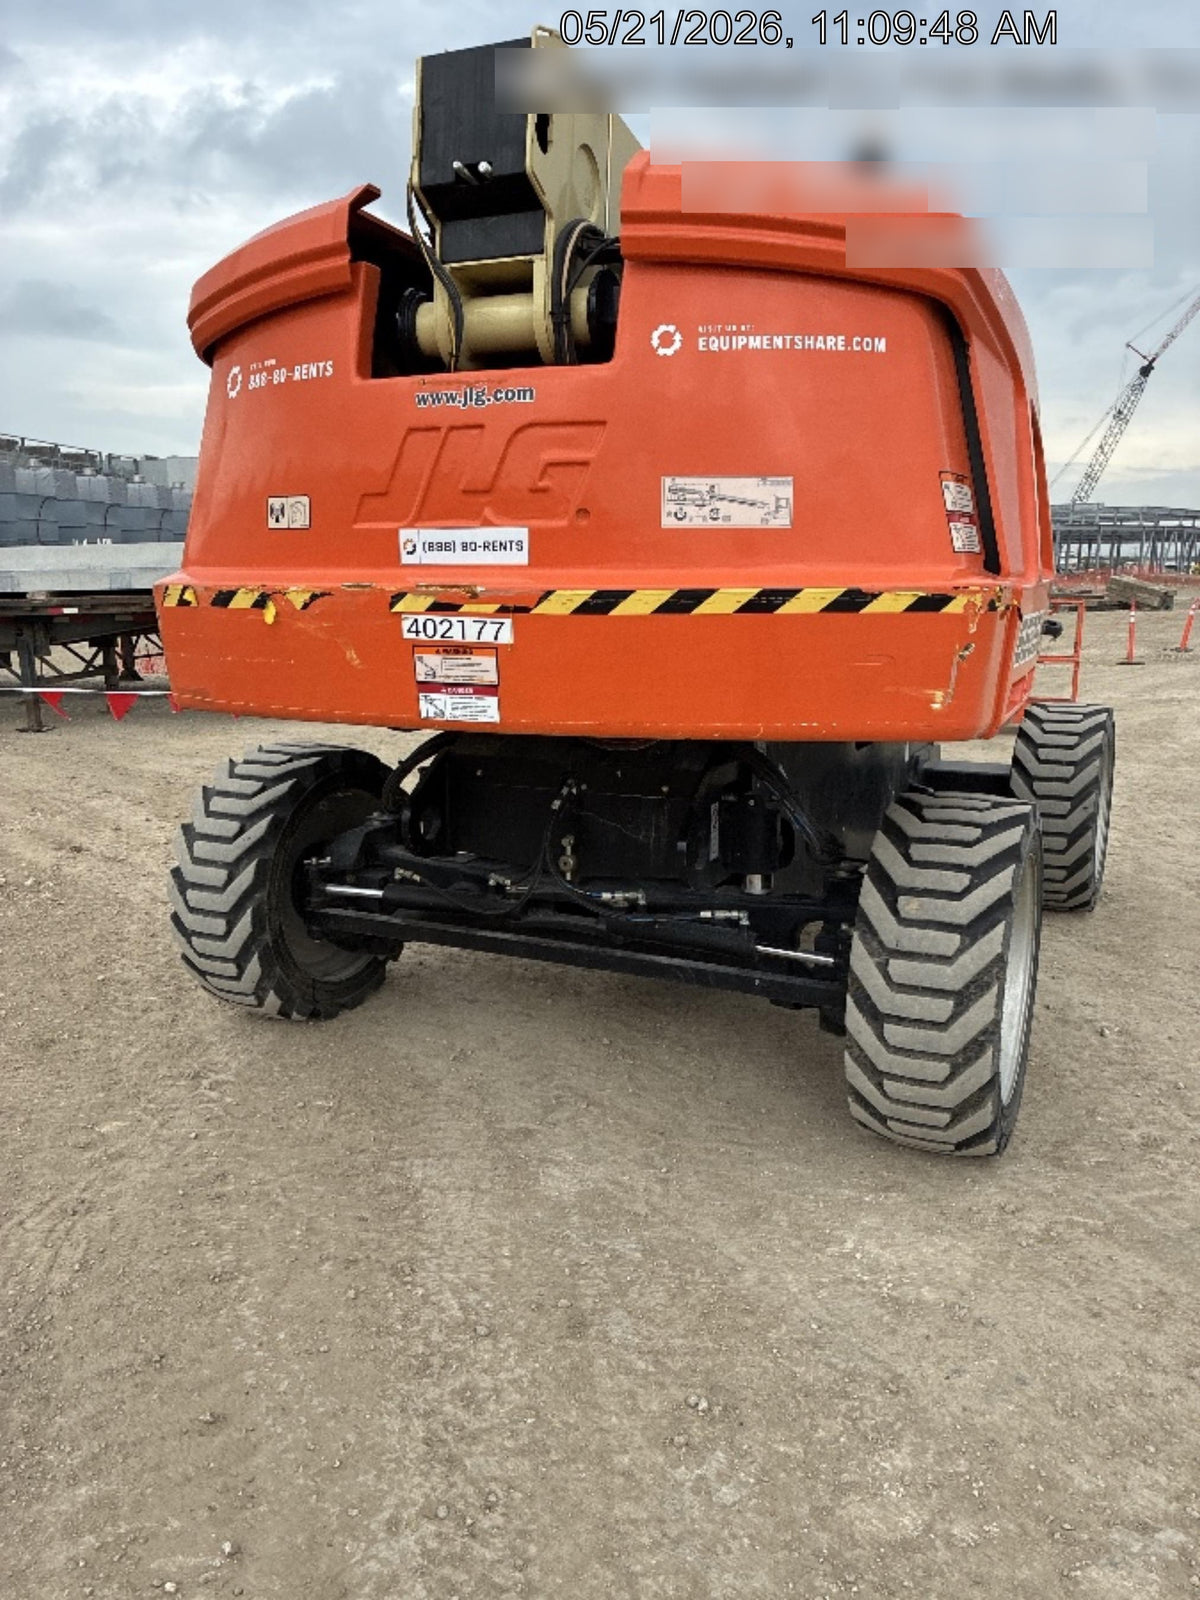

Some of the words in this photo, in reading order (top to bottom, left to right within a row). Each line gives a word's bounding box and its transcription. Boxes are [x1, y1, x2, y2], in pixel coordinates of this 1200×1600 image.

[698, 334, 887, 353] EQUIPMENTSHARE.COM
[416, 386, 535, 408] www.jlg.com
[406, 617, 506, 641] 402177
